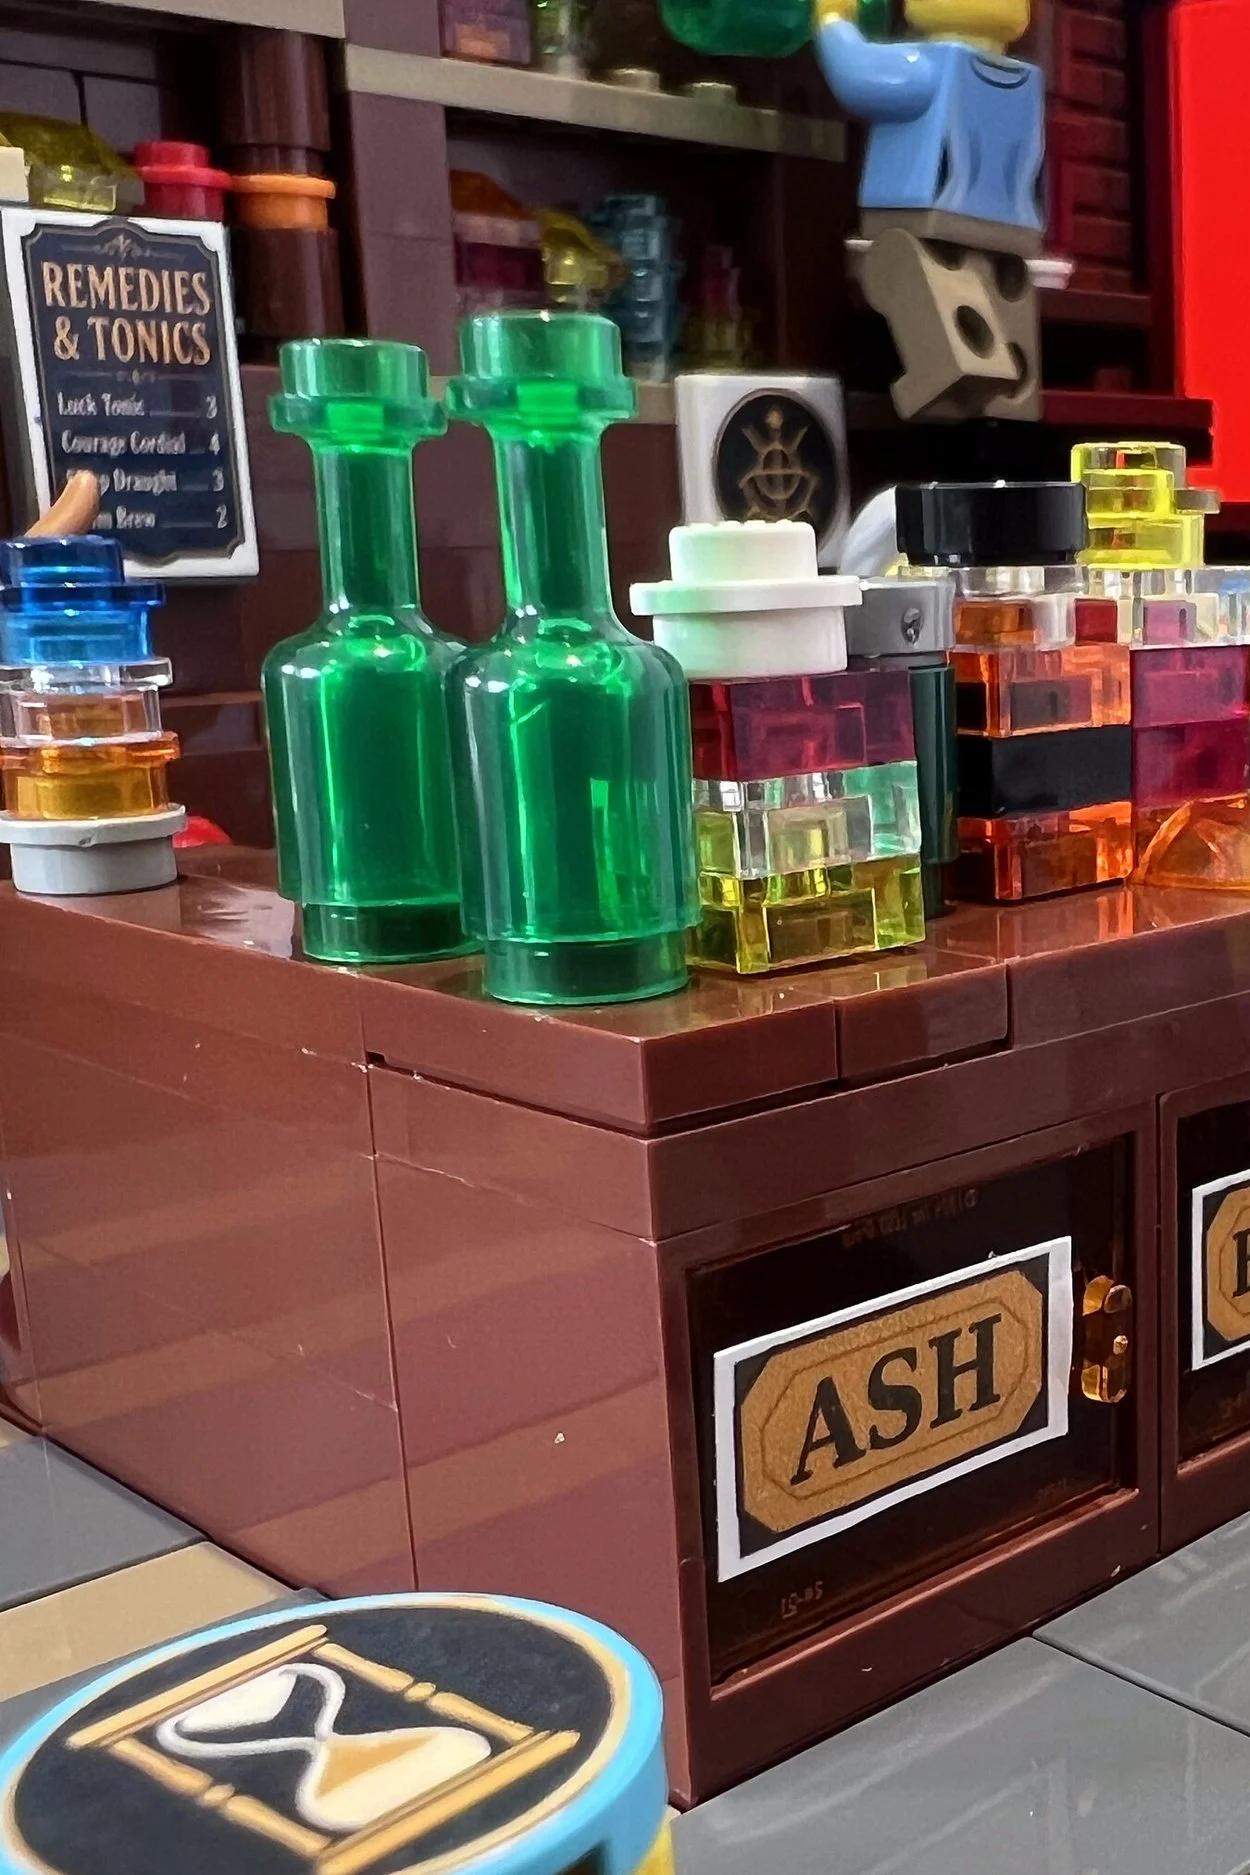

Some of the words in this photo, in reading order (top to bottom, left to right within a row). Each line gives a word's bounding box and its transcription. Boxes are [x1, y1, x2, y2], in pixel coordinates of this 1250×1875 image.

[43, 261, 211, 316] REMEDIES
[54, 315, 80, 360] &
[87, 316, 211, 366] TONICS
[57, 391, 97, 416] Luck
[61, 429, 127, 458] Courage
[130, 430, 186, 455] Cordial
[209, 431, 221, 456] 4
[113, 468, 178, 496] Draught
[116, 506, 156, 529] Brew
[216, 504, 228, 529] 2
[790, 1313, 1002, 1486] ASH
